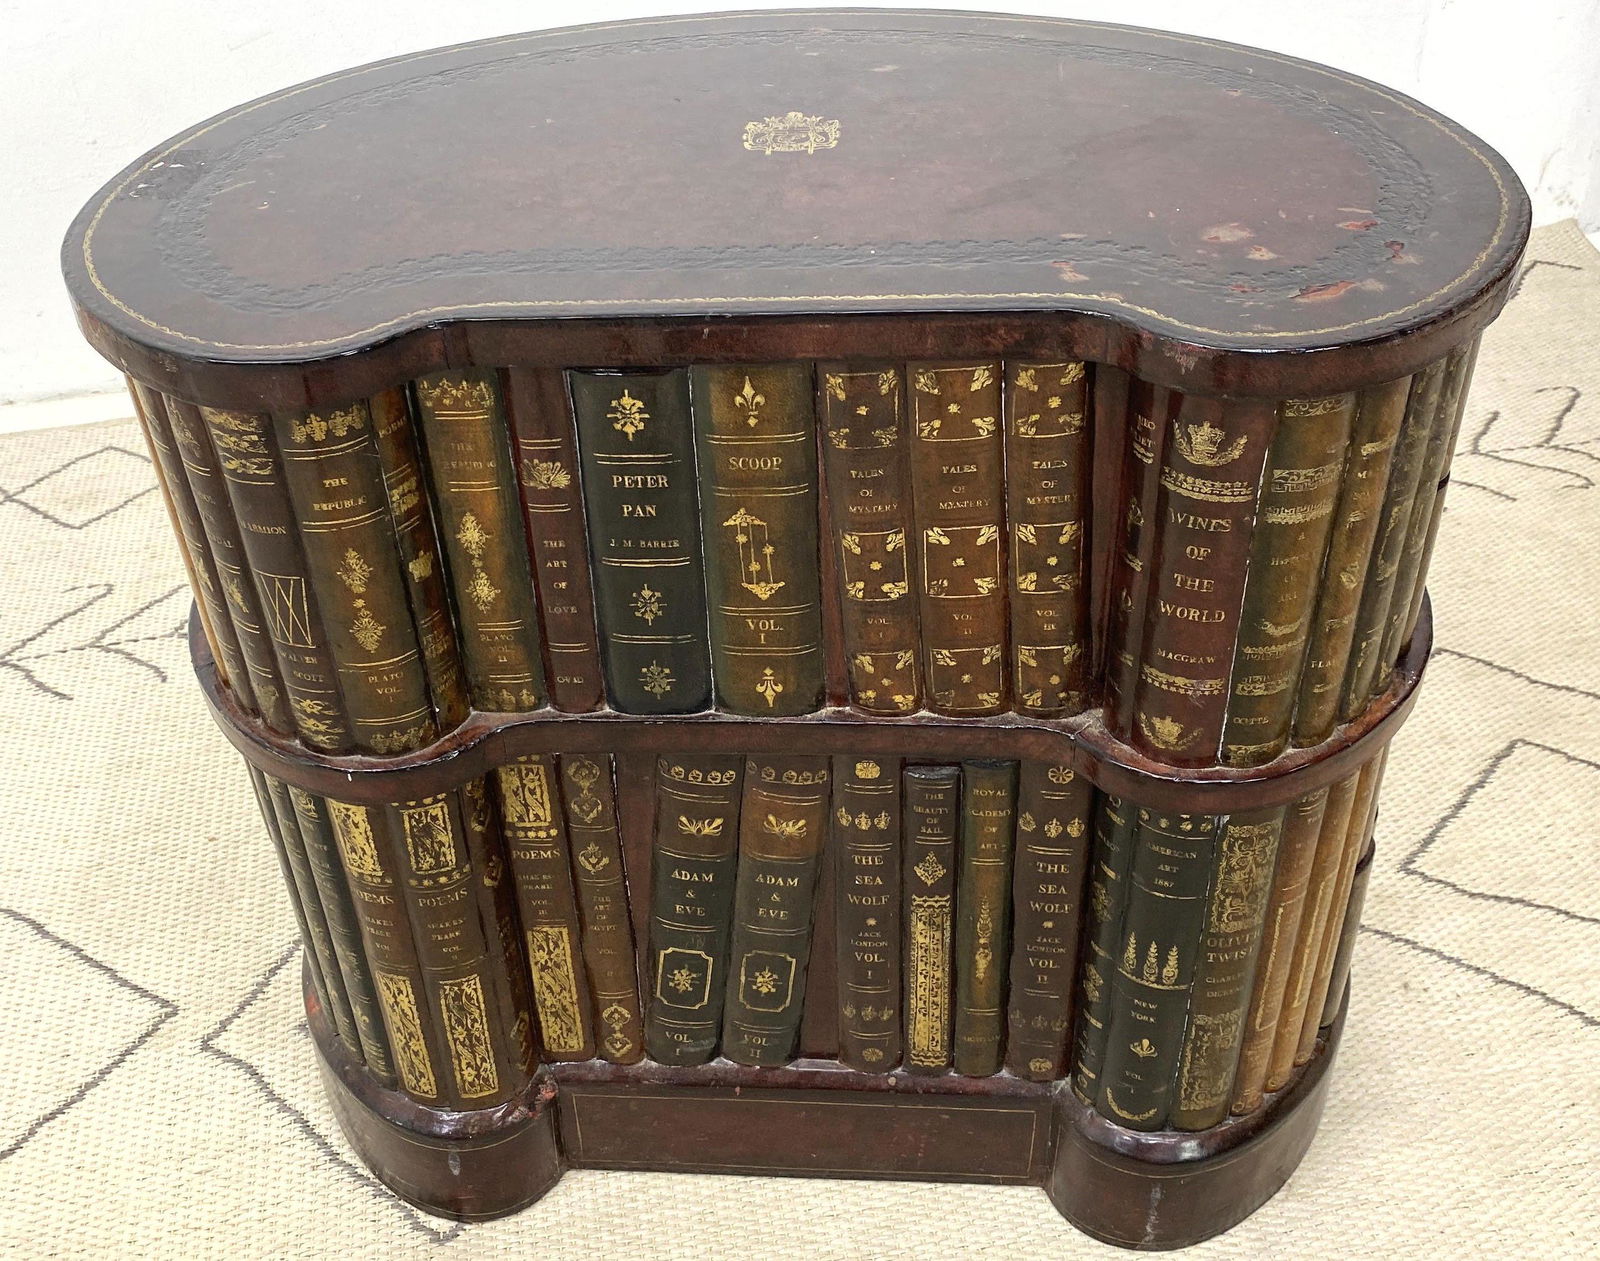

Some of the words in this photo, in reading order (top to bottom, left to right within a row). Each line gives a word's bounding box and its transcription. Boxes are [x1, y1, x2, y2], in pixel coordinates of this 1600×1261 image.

[728, 456, 783, 471] SCOOP
[942, 464, 978, 474] TALES
[1032, 460, 1069, 470] TALES
[850, 468, 885, 479] TALES
[323, 477, 349, 488] THE
[612, 474, 669, 488] PETER
[1041, 480, 1058, 489] OF
[313, 495, 367, 511] REPUBLIC
[621, 504, 658, 517] PAN
[1168, 508, 1232, 533] WINES
[543, 540, 566, 548] THE
[639, 539, 680, 549] BARRIE
[1185, 545, 1211, 561] OF
[546, 560, 568, 568] ART
[553, 581, 568, 589] OF
[1173, 572, 1215, 593] THE
[548, 605, 578, 614] LOVE
[1158, 599, 1226, 624] WORLD
[746, 619, 784, 631] VOL.
[759, 633, 766, 644] I
[1156, 648, 1217, 664] MACGRAW
[368, 672, 404, 684] PLATO
[972, 788, 1008, 797] ROYAL
[913, 804, 949, 815] BEAUTY
[920, 826, 944, 834] SAIL
[512, 848, 561, 860] POEMS
[1145, 842, 1198, 859] AMERICAN
[851, 855, 884, 865] THE
[1036, 861, 1070, 874] THE
[1158, 863, 1180, 873] ART
[671, 868, 715, 883] ADAM
[755, 873, 800, 887] ADAM
[855, 875, 884, 885] SEA
[685, 889, 696, 898] &
[1038, 884, 1068, 895] SEA
[418, 887, 468, 907] POEMS
[770, 892, 782, 902] &
[847, 893, 890, 905] WOLF
[674, 904, 706, 917] EVE
[1029, 900, 1073, 914] WOLF
[758, 907, 789, 921] EVE
[850, 938, 888, 947] LONDON
[1026, 944, 1067, 954] LONDON
[866, 970, 873, 979] I
[1037, 974, 1049, 984] II
[1134, 998, 1158, 1010] NEW
[1130, 1010, 1157, 1023] YORK
[750, 1048, 762, 1058] II
